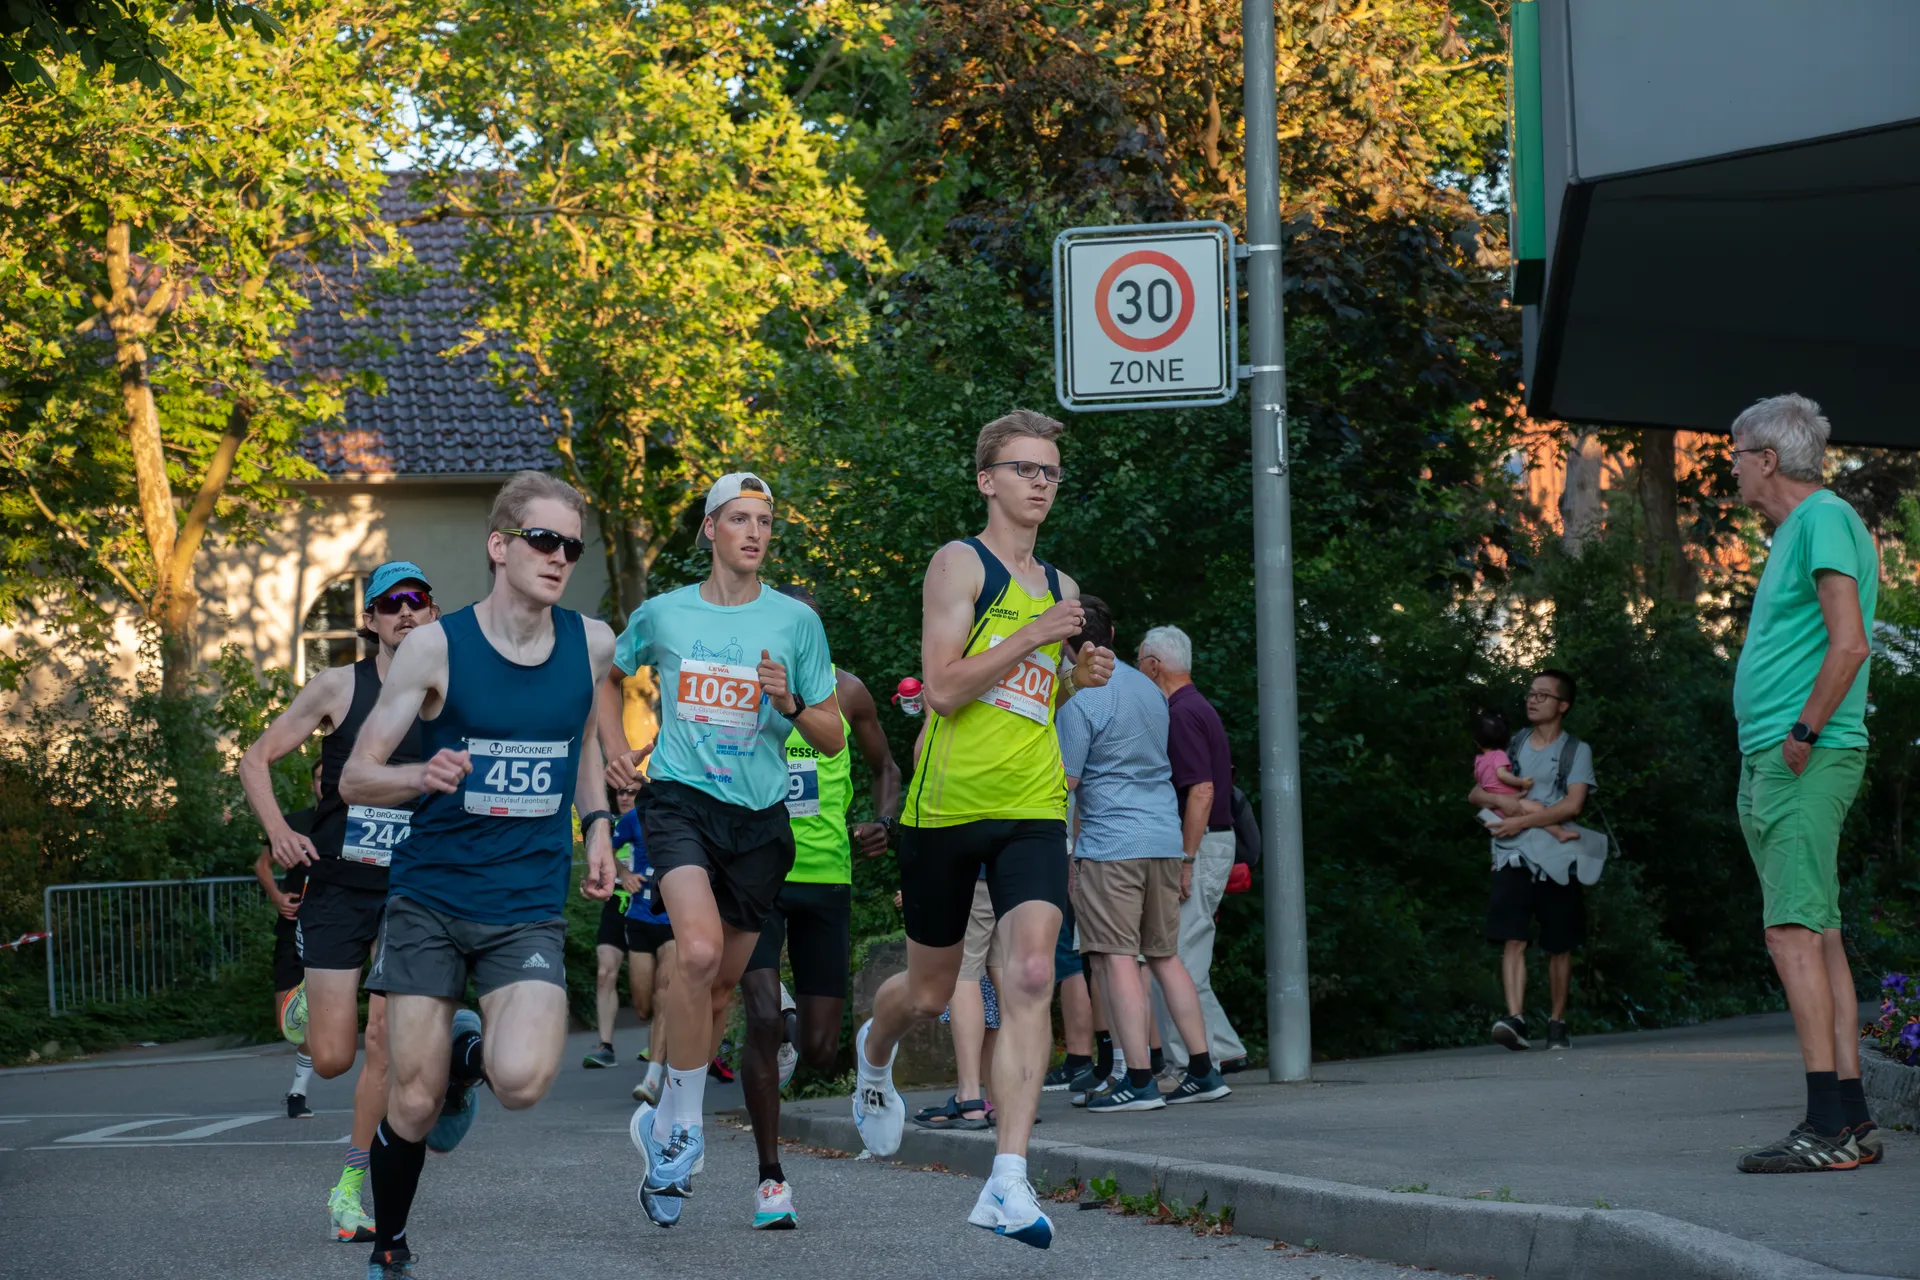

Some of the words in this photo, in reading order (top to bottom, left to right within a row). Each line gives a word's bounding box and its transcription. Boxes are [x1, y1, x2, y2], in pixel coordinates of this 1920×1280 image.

[1116, 278, 1173, 325] 30
[1110, 358, 1184, 385] ZONE
[990, 607, 1019, 617] panzeri
[708, 665, 730, 674] LEWA
[998, 661, 1052, 703] 204
[684, 675, 755, 709] 1062
[504, 744, 553, 755] BRÜCKNER
[484, 760, 552, 793] 456
[494, 796, 520, 805] Citylauf
[521, 797, 550, 805] Leonberg
[522, 959, 550, 969] adidas
